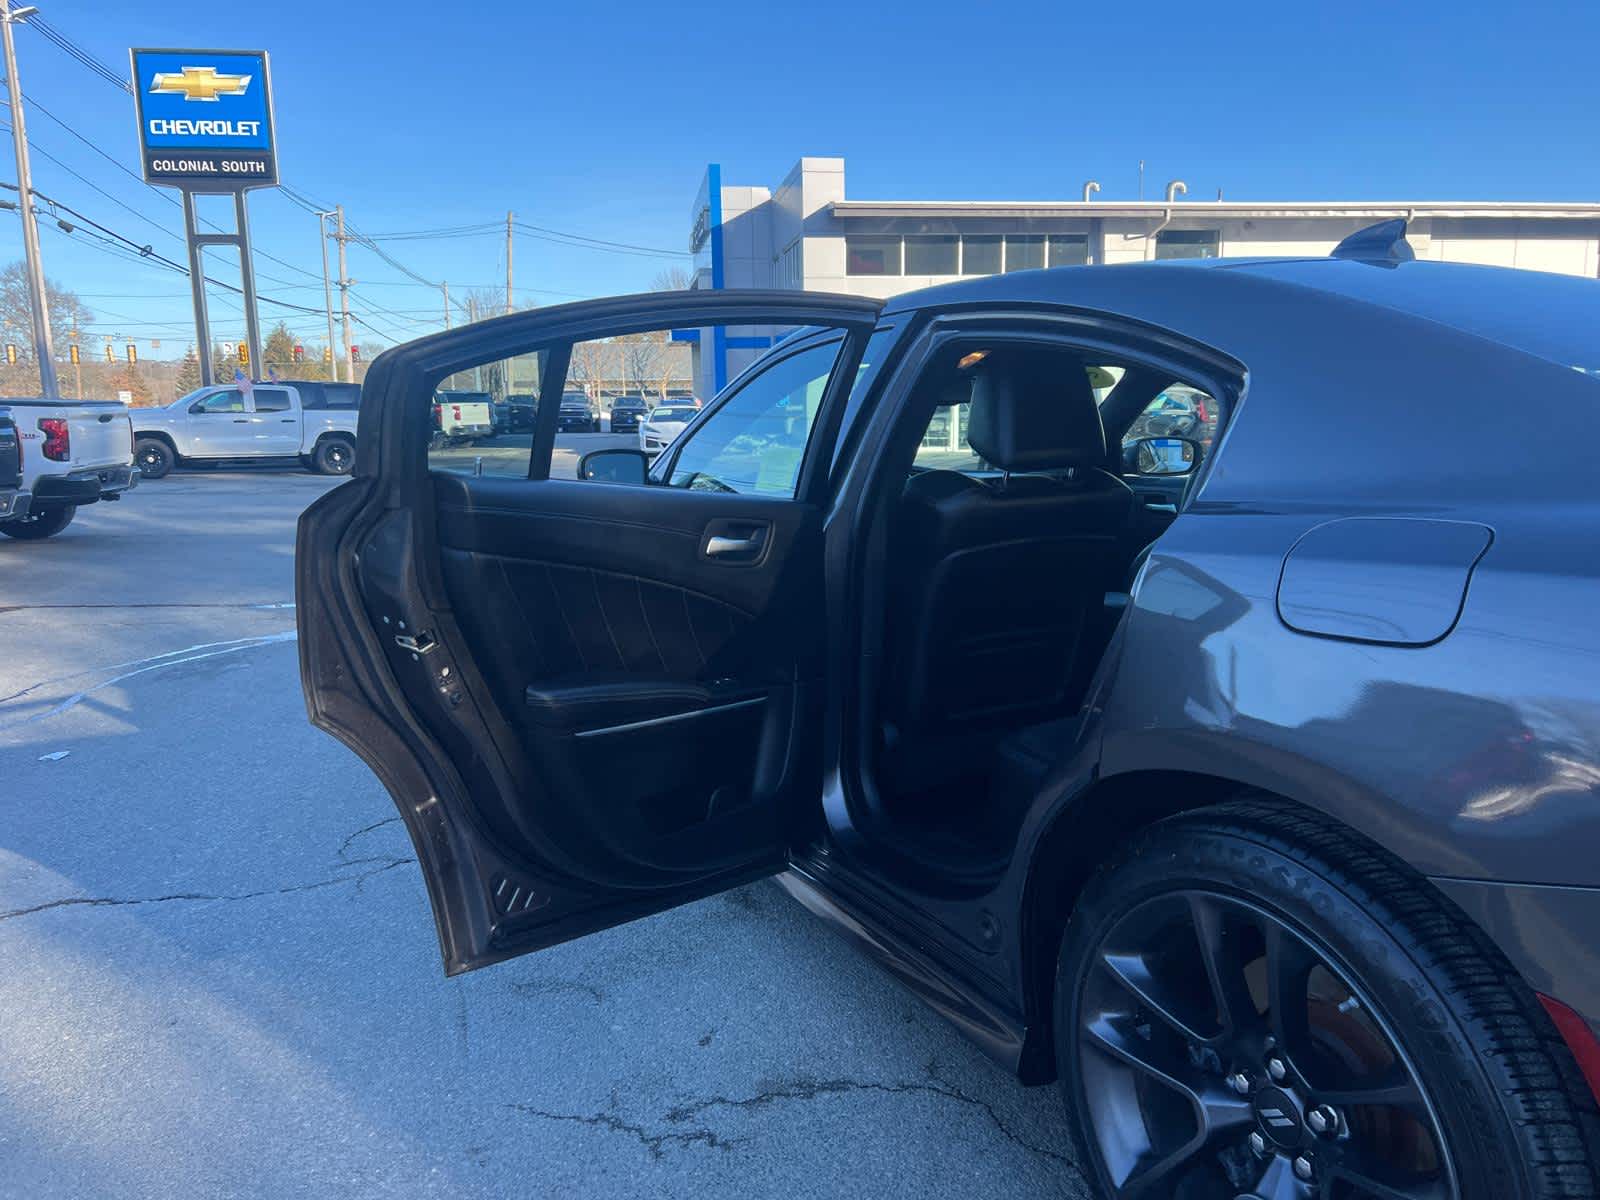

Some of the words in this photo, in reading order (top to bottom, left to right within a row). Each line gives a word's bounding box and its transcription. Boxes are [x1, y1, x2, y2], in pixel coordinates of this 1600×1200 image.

[150, 119, 260, 136] CHEVROLET
[153, 160, 217, 172] COLONIAL
[222, 161, 265, 173] SOUTH
